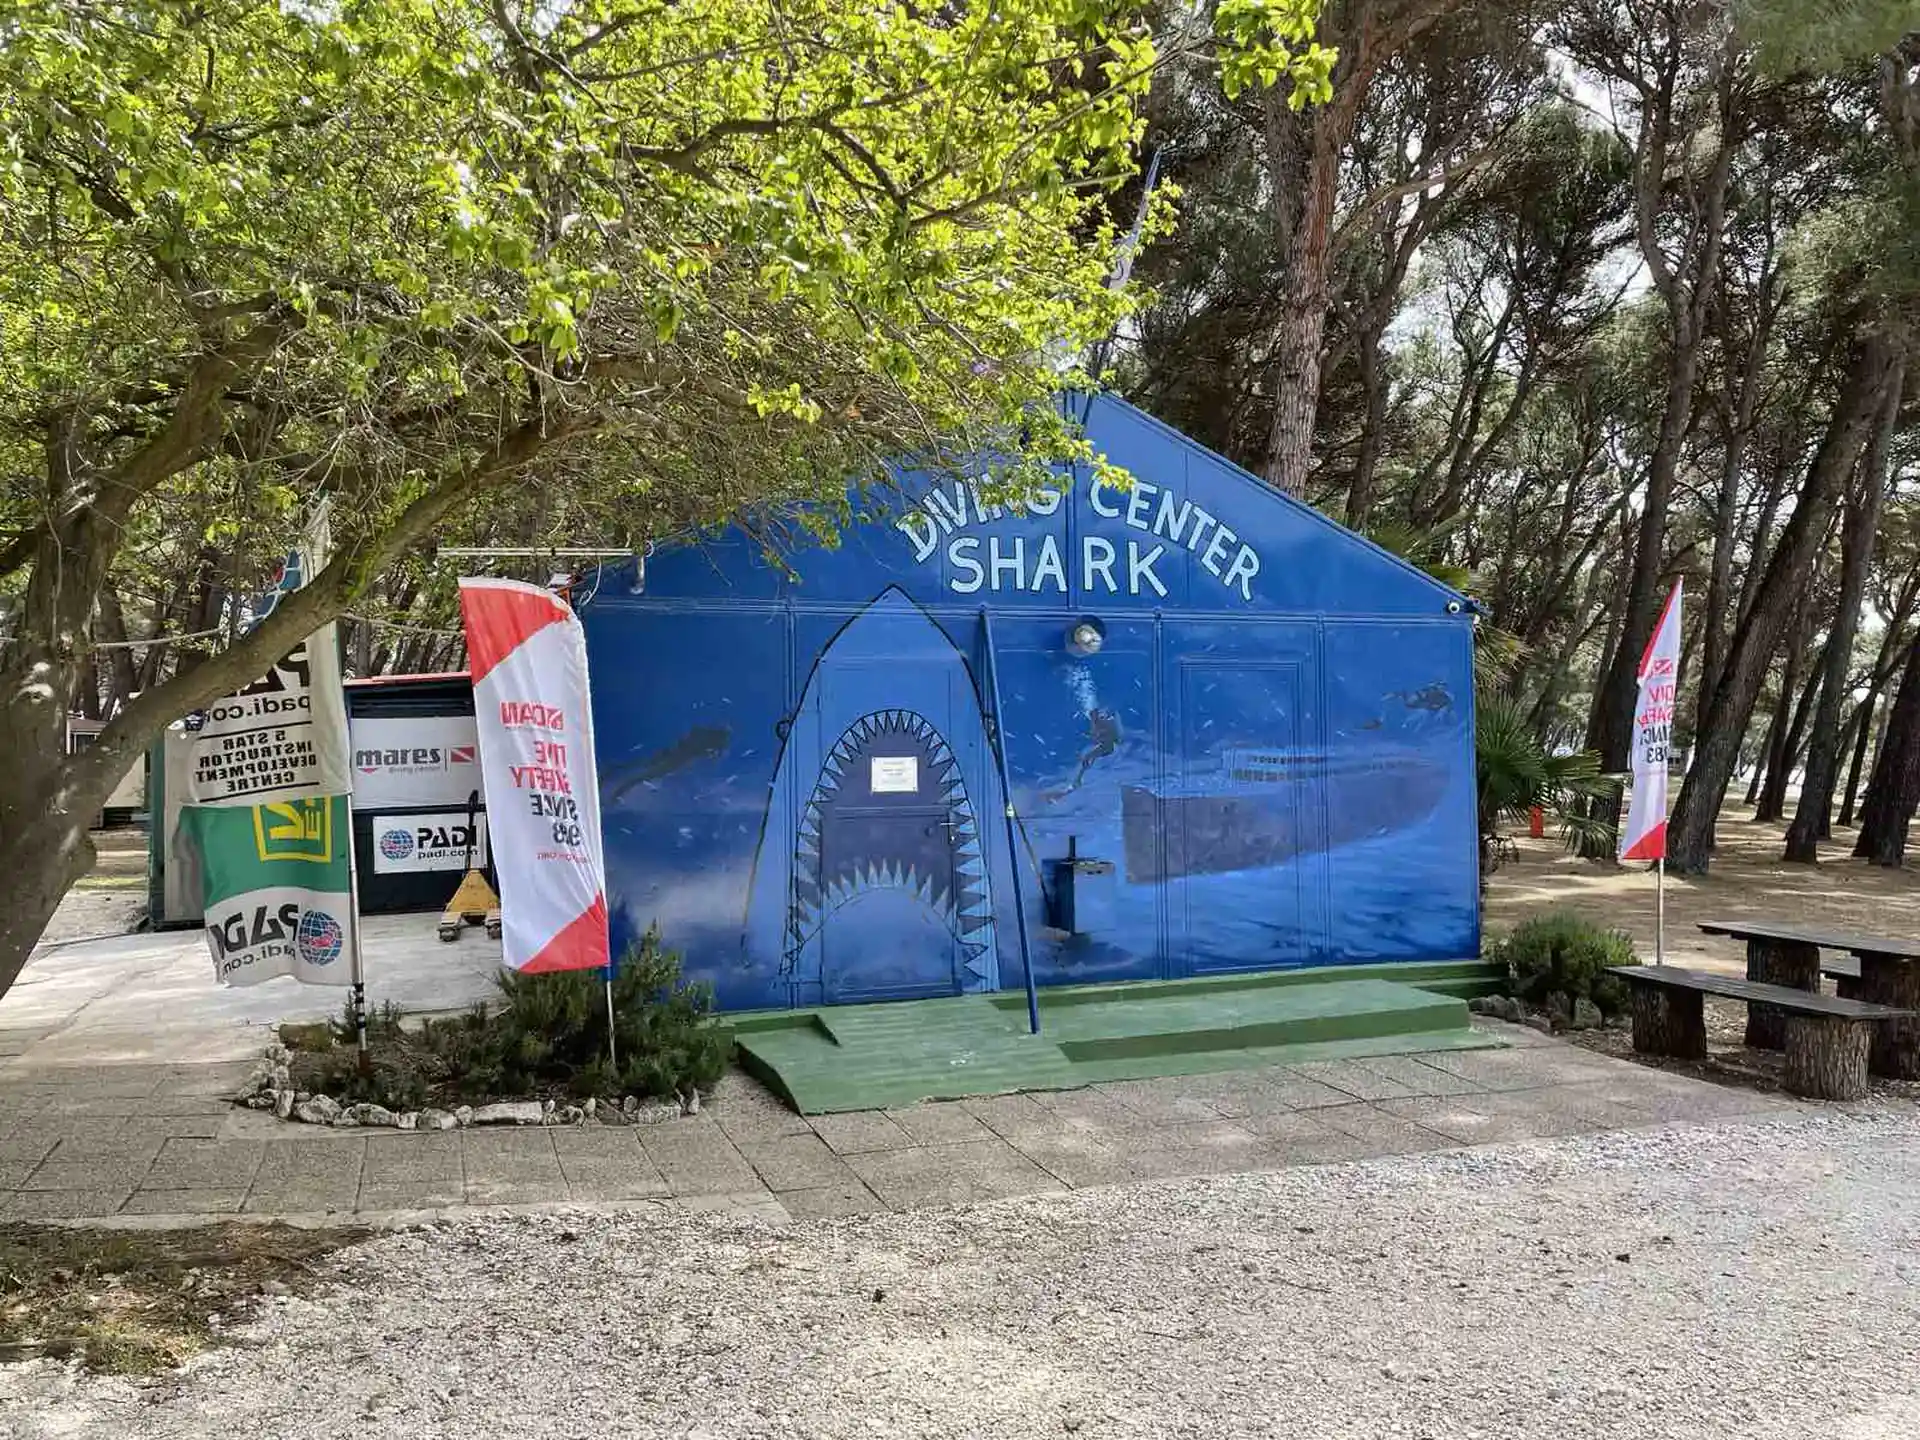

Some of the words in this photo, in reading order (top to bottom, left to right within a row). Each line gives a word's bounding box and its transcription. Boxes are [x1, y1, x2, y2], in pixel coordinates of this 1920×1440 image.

[1089, 474, 1260, 600] CENTER
[948, 534, 1168, 598] SHARK
[355, 747, 441, 766] mares
[416, 825, 477, 849] PADI
